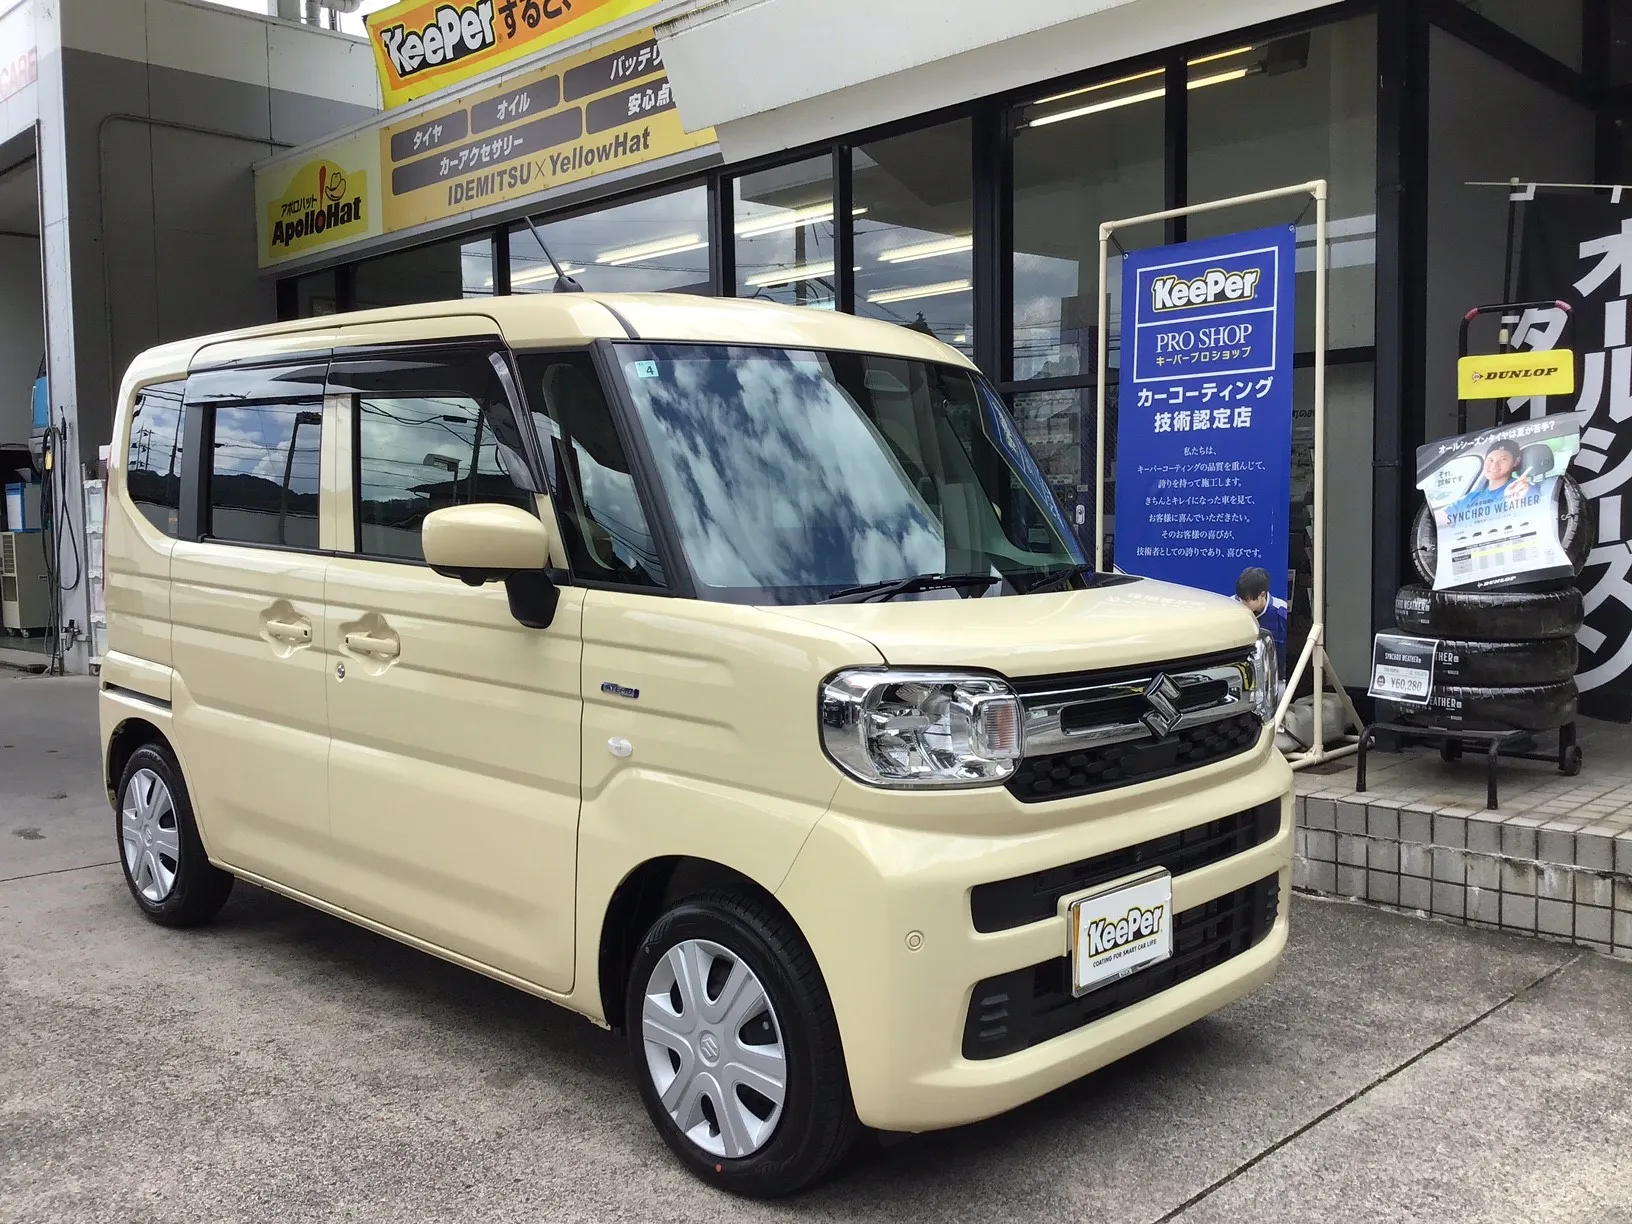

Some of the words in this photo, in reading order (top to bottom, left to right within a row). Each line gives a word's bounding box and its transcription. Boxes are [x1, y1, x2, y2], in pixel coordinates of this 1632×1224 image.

[380, 0, 496, 77] KeePer
[496, 92, 530, 121] オイル
[628, 84, 675, 116] 安心点
[413, 124, 443, 150] タイヤ
[439, 135, 524, 176] カーアクセサリー
[448, 161, 531, 206] IDEMITSU
[549, 126, 650, 177] YellowHat
[281, 194, 318, 218] アポロハット
[271, 197, 362, 247] ApolloHat
[1152, 268, 1260, 312] KeePer
[1156, 330, 1195, 353] PRO
[1199, 323, 1253, 349] SHOP
[1156, 346, 1252, 366] キーパープロショップ
[646, 365, 654, 375] 4
[1485, 367, 1558, 381] DUNLOP
[1137, 376, 1274, 407] カーコーティング
[1154, 406, 1252, 433] 技術認定店
[1184, 446, 1217, 457] 私たちは、
[1137, 461, 1266, 474] キーパーコーティングの品質を重んじて、
[1157, 477, 1242, 489] 誇りを持って施工します。
[1145, 495, 1256, 506] きちんとキレイになった車を見て、
[1447, 505, 1491, 525] SYNCHRO
[1494, 494, 1540, 514] WEATHER
[1148, 513, 1251, 523] お客様に喜んでいただきたい。
[1161, 530, 1235, 540] そのお客様の喜びが、
[1483, 576, 1517, 587] DUNLOP
[1435, 651, 1454, 662] THER
[1391, 676, 1422, 692] ¥60,280
[1429, 696, 1456, 708] EATHER
[1088, 905, 1163, 958] KeePer
[1093, 955, 1112, 967] COATING
[1113, 952, 1121, 960] FOR
[1123, 946, 1137, 956] SMART
[1138, 942, 1146, 950] CAR
[1147, 939, 1156, 947] LIFE
